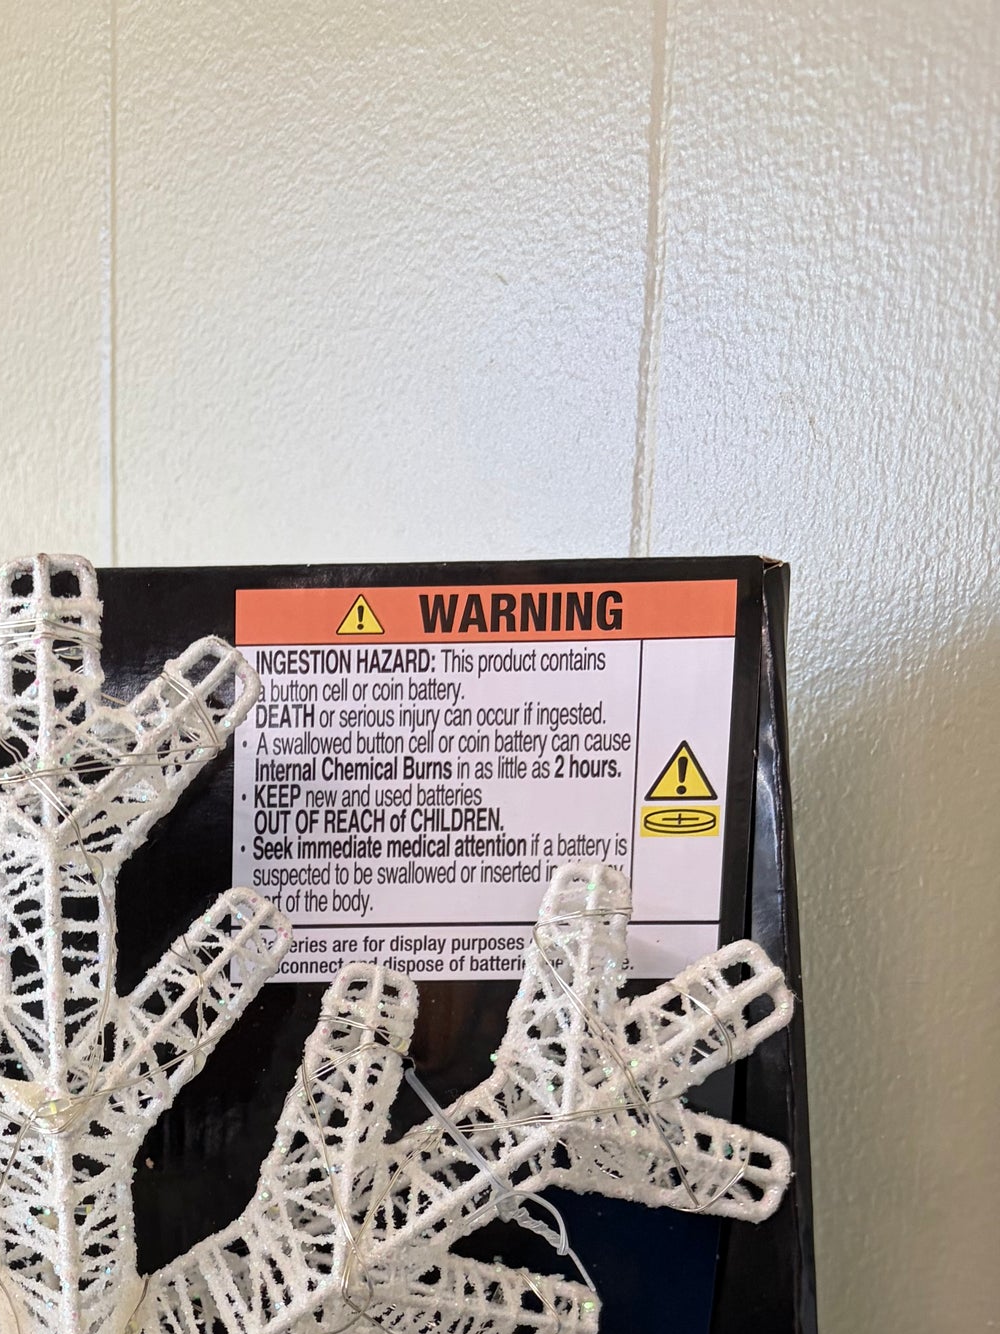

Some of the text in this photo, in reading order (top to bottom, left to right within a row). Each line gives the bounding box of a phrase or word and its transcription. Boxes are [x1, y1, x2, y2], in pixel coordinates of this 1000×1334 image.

[418, 590, 624, 635] WARNING
[256, 647, 606, 678] INGESTION HAZARD: This product contains
[270, 679, 318, 701] button
[322, 678, 348, 701] cell
[352, 682, 369, 701] or
[372, 677, 404, 701] coin
[408, 677, 465, 706] battery.
[255, 700, 606, 733] DEATH or serious injury can occur if ingested.
[256, 729, 631, 758] A swallowed button cell or coin battery can cause
[255, 754, 621, 782] Internal Chemical Burns in as little as 2 hours.
[254, 782, 482, 808] KEEP new and used batteries
[254, 807, 504, 835] OUT OF REACH of CHILDREN.
[252, 833, 628, 862] Seek immediate medical attention if a battery is
[252, 862, 331, 892] suspected
[335, 863, 349, 885] to
[353, 862, 373, 885] be
[376, 860, 456, 885] swallowed
[460, 865, 477, 883] or
[480, 860, 541, 883] inserted
[285, 889, 301, 912] of
[304, 889, 328, 912] the
[332, 888, 373, 917] body.
[332, 939, 358, 953] are
[362, 936, 385, 952] for
[389, 935, 446, 954] display
[450, 937, 525, 956] purposes
[448, 956, 466, 971] of
